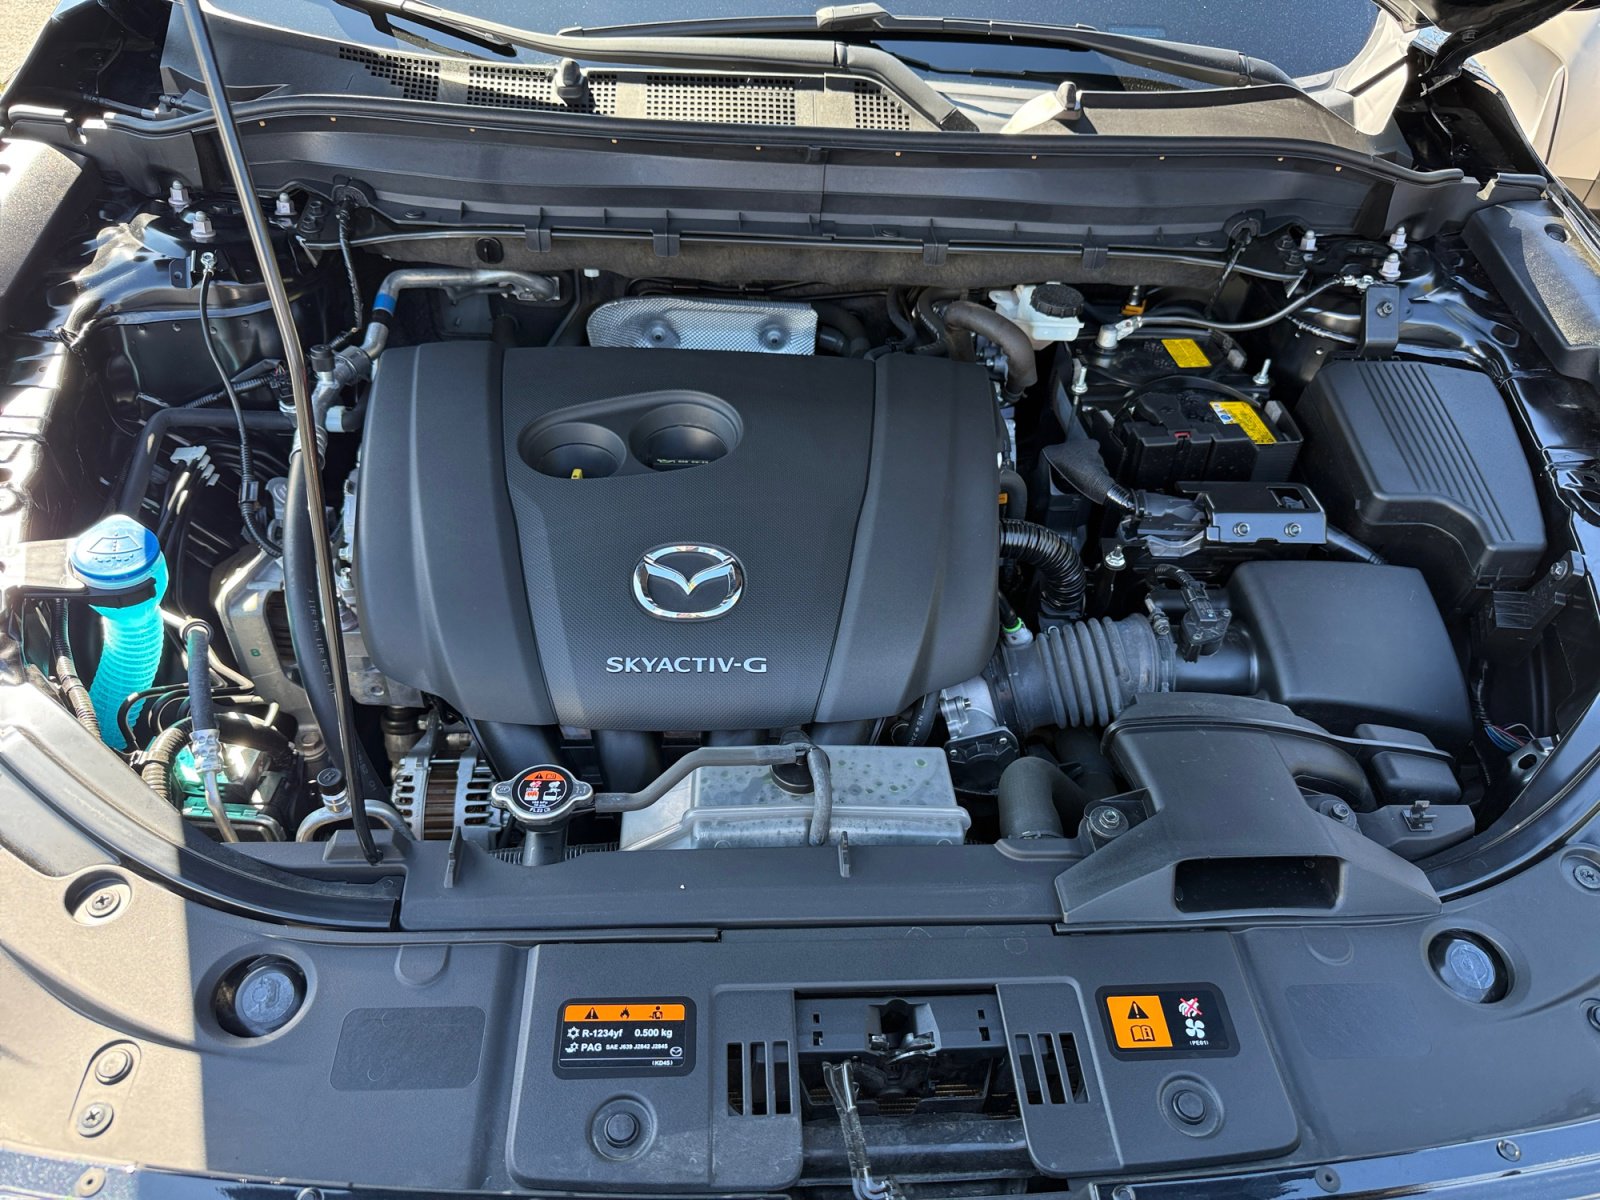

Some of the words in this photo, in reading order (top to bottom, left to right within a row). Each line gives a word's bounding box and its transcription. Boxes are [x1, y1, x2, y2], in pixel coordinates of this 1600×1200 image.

[606, 656, 767, 673] SKYACTIV-G
[582, 1029, 623, 1039] R-1234yf
[634, 1028, 659, 1037] 0.500
[661, 1028, 673, 1039] kg
[580, 1043, 602, 1051] PAG
